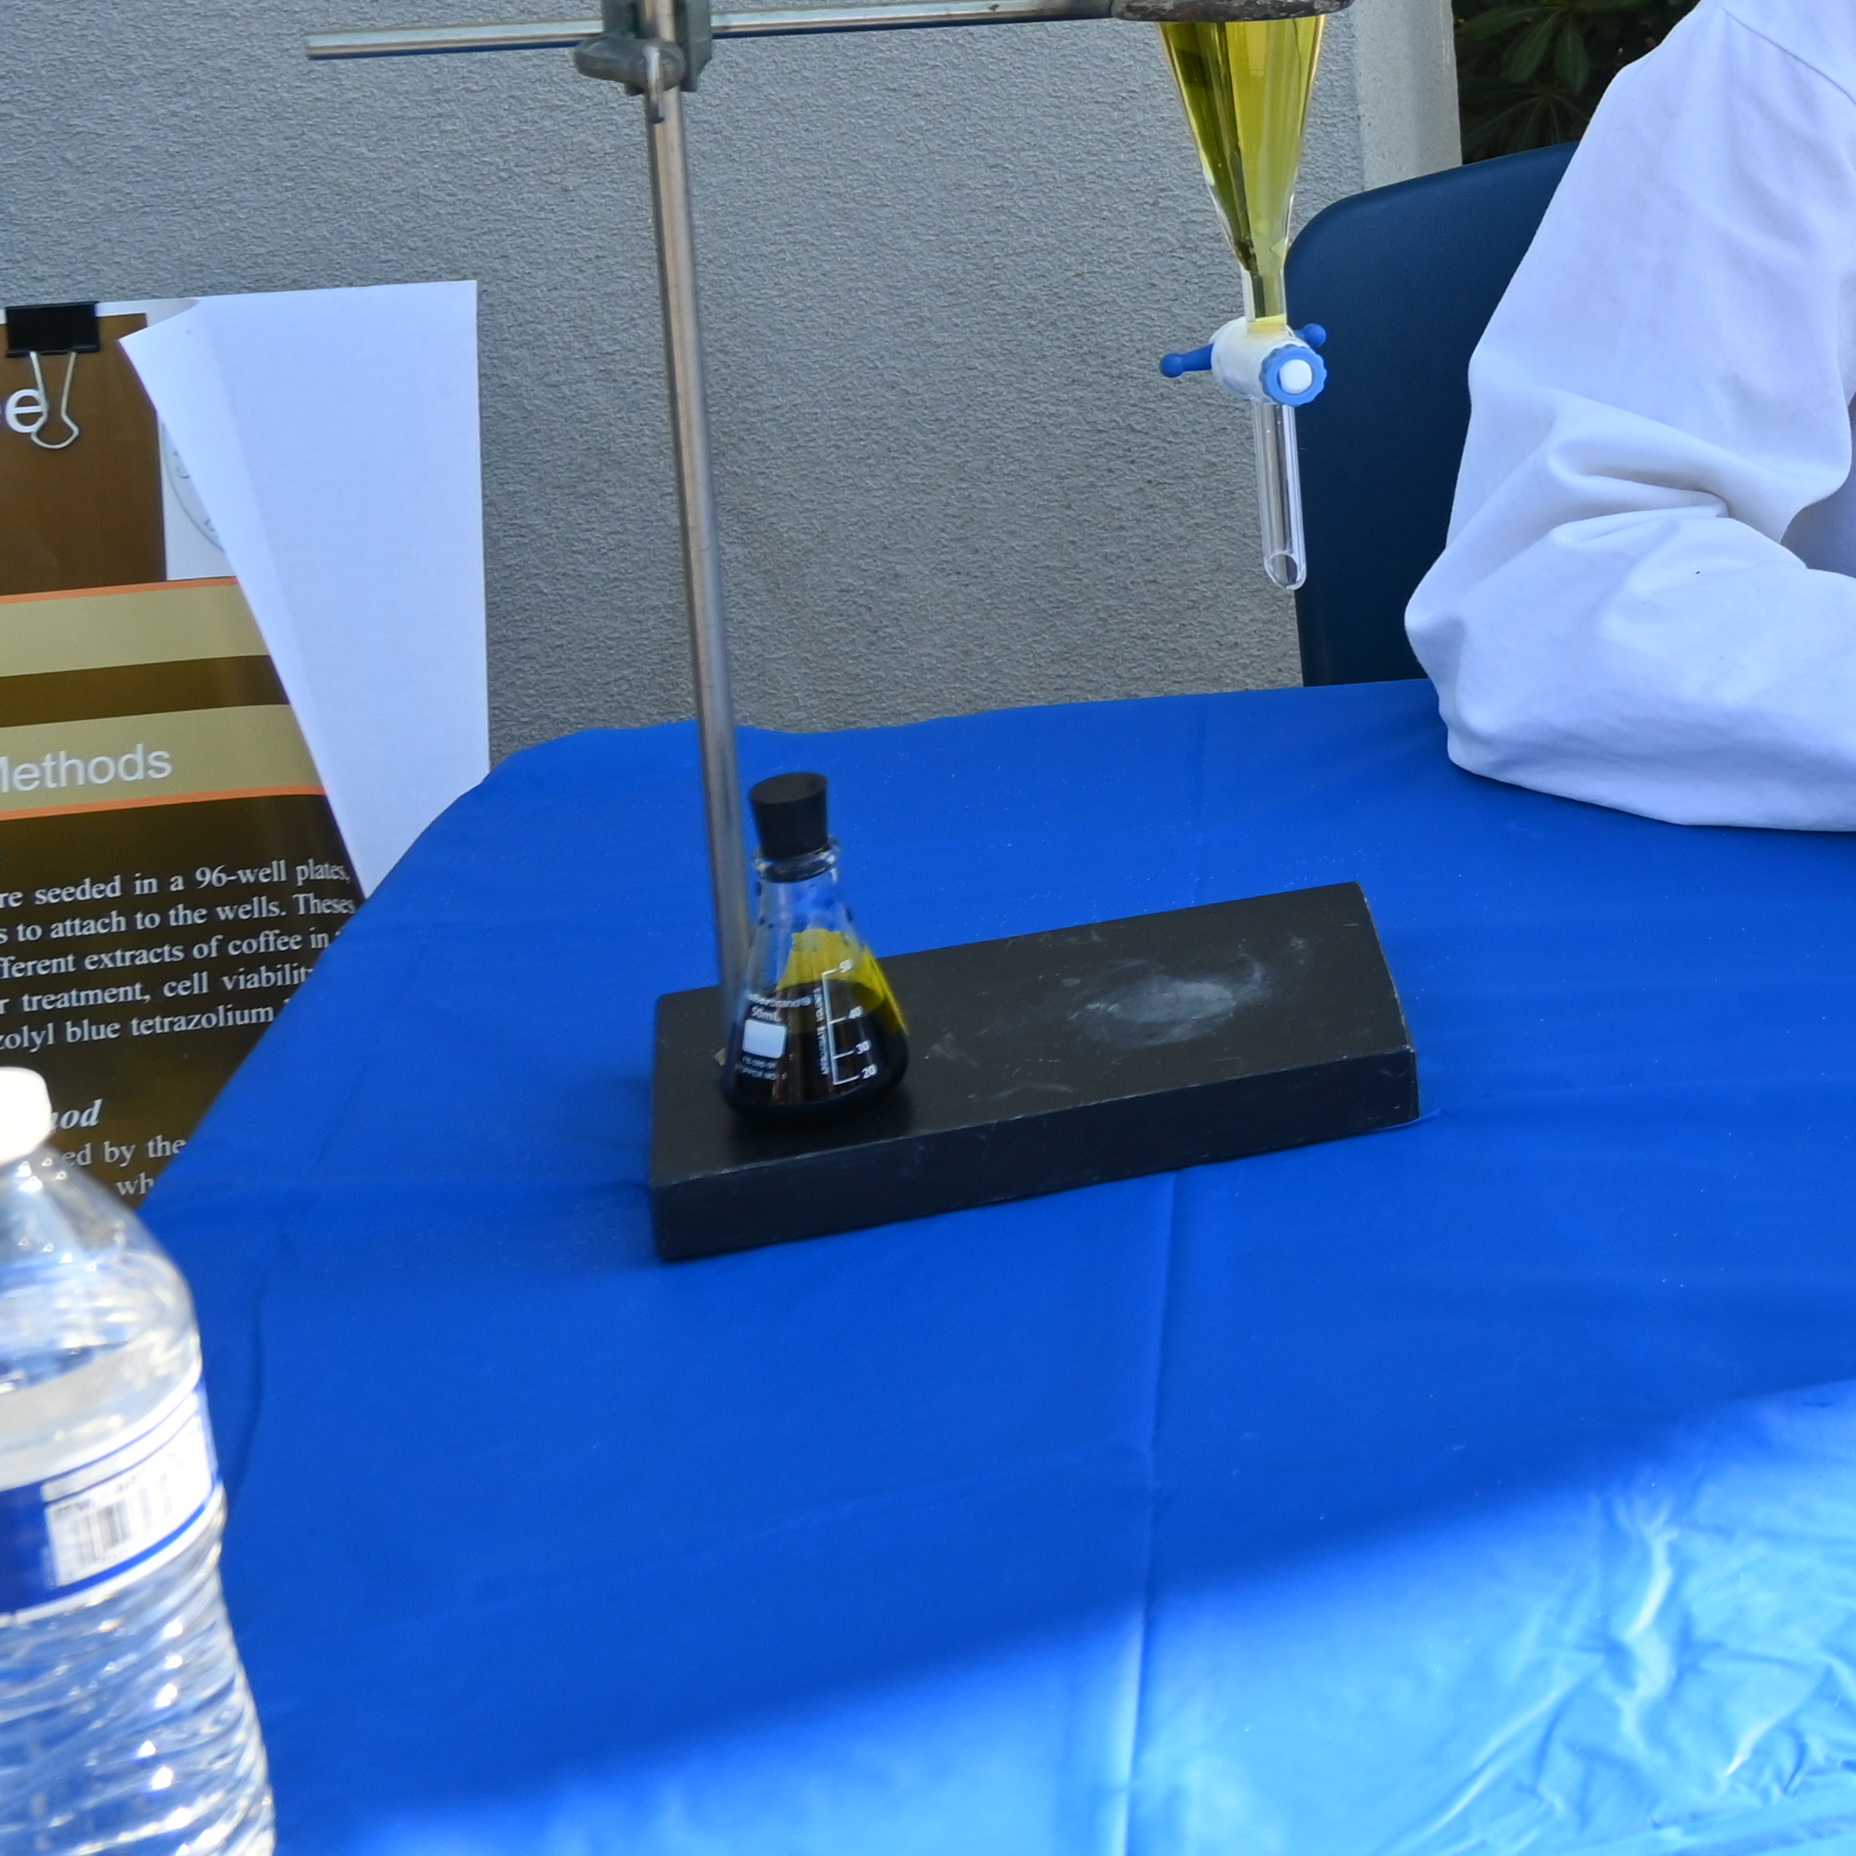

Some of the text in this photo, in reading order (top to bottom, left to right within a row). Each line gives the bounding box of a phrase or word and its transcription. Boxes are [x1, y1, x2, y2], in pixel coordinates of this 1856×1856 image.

[35, 874, 123, 906] seeded
[134, 872, 158, 895] in
[170, 876, 185, 892] a
[196, 859, 288, 889] 96-well
[296, 859, 352, 886] plates,
[17, 921, 43, 943] to
[50, 912, 127, 940] attach
[135, 909, 162, 931] to
[168, 903, 208, 927] the
[215, 896, 287, 923] wells.
[84, 943, 185, 971] extracts
[193, 935, 224, 959] of
[227, 927, 303, 955] coffee
[309, 927, 330, 949] in
[22, 981, 152, 1012] treatment,
[163, 972, 209, 999] cell
[222, 963, 315, 993] viabilit
[65, 1020, 122, 1044] blue
[131, 1004, 276, 1038] tetrazolium
[751, 1006, 782, 1022] 50mL
[855, 1039, 872, 1055] 30
[861, 1063, 878, 1080] 20
[104, 1141, 137, 1168] by
[148, 1134, 187, 1159] the
